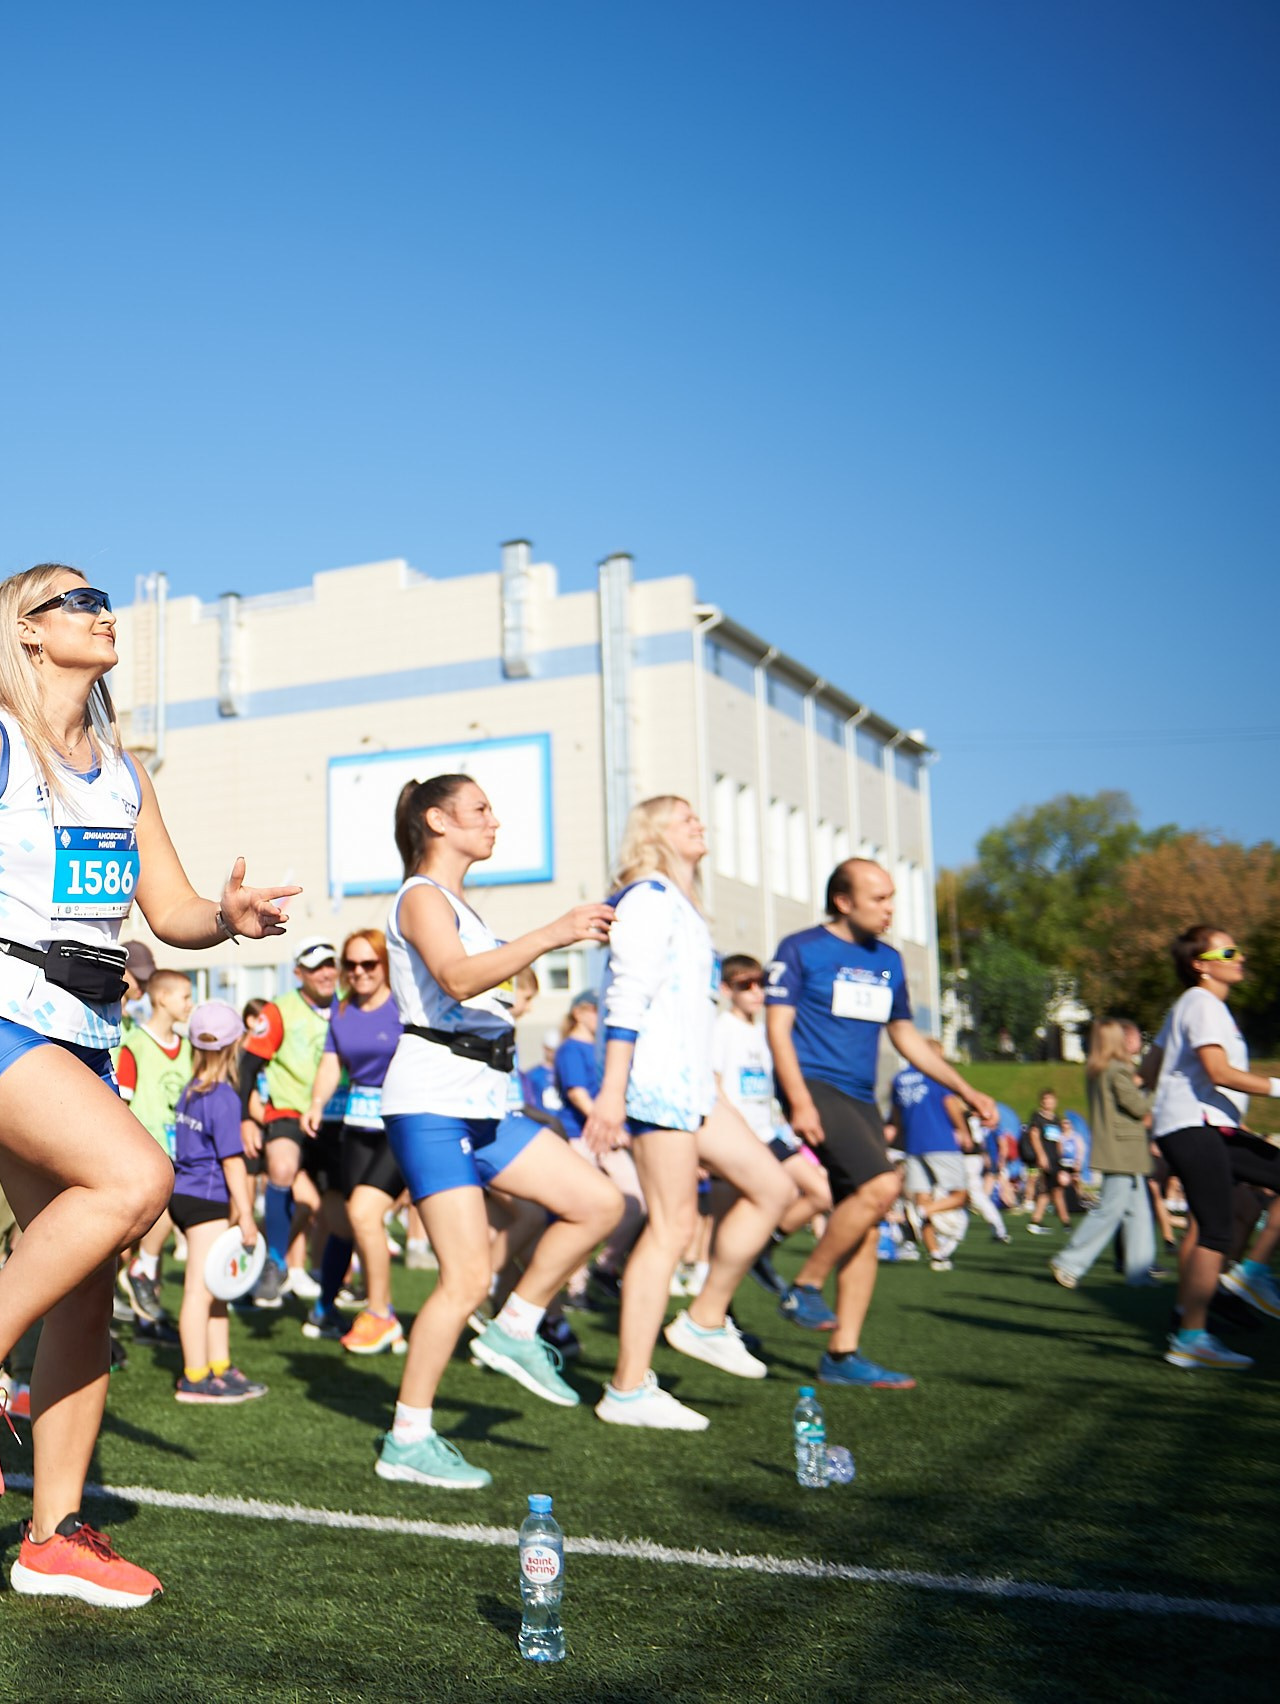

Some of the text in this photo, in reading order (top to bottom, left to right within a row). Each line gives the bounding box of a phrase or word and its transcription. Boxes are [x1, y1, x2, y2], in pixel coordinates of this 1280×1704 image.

[83, 831, 128, 841] ДИНАМОВСКАЯ
[98, 841, 117, 849] МИЛЯ
[67, 860, 134, 895] 1586
[528, 1557, 552, 1565] saint
[525, 1564, 555, 1575] spring
